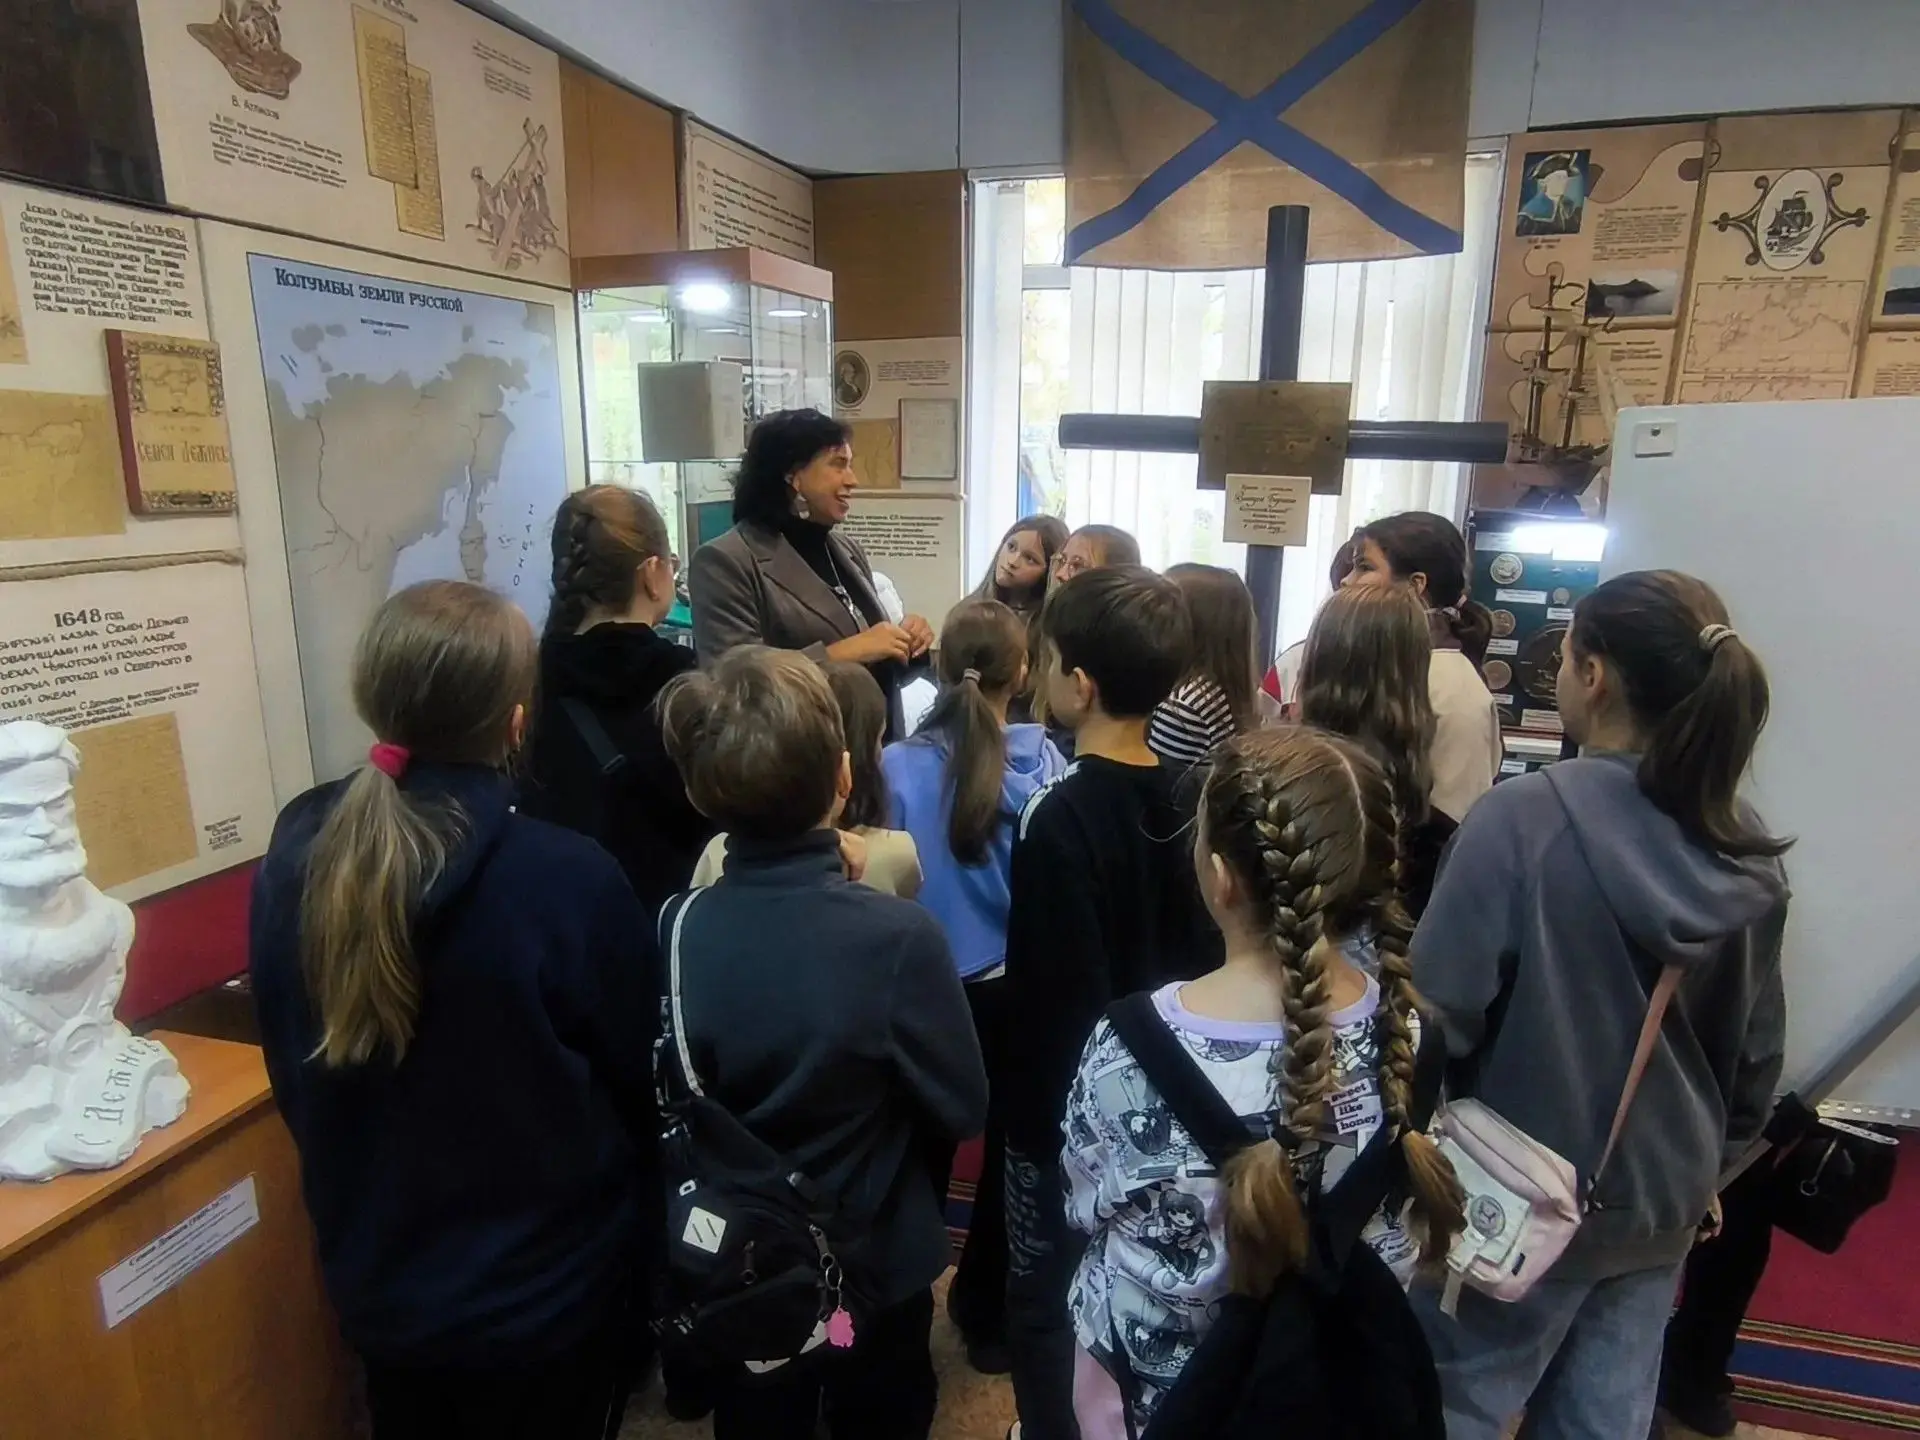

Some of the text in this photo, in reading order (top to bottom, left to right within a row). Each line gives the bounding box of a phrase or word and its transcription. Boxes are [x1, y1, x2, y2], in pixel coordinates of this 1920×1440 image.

[275, 267, 464, 312] КОЛУМБЫ ЗЕМЛИ РУССКОЙ
[54, 608, 101, 628] 1648
[0, 633, 55, 650] БИРСКИЙ
[61, 630, 99, 641] КАЗАК
[1, 646, 79, 665] ОВАРИЩАМИ
[83, 643, 98, 652] НА
[102, 635, 137, 649] УТЛОЙ
[0, 642, 187, 680] ЪЕХАЛ ЧУКОТСКИЙ ПОЛУОСТРОВ
[55, 671, 99, 685] ПРОХОД
[104, 667, 119, 676] ИЗ
[124, 657, 182, 673] СЕВЕРНОГО
[38, 690, 76, 703] ОКЕАН
[1339, 1103, 1363, 1115] like
[1341, 1115, 1377, 1130] honey
